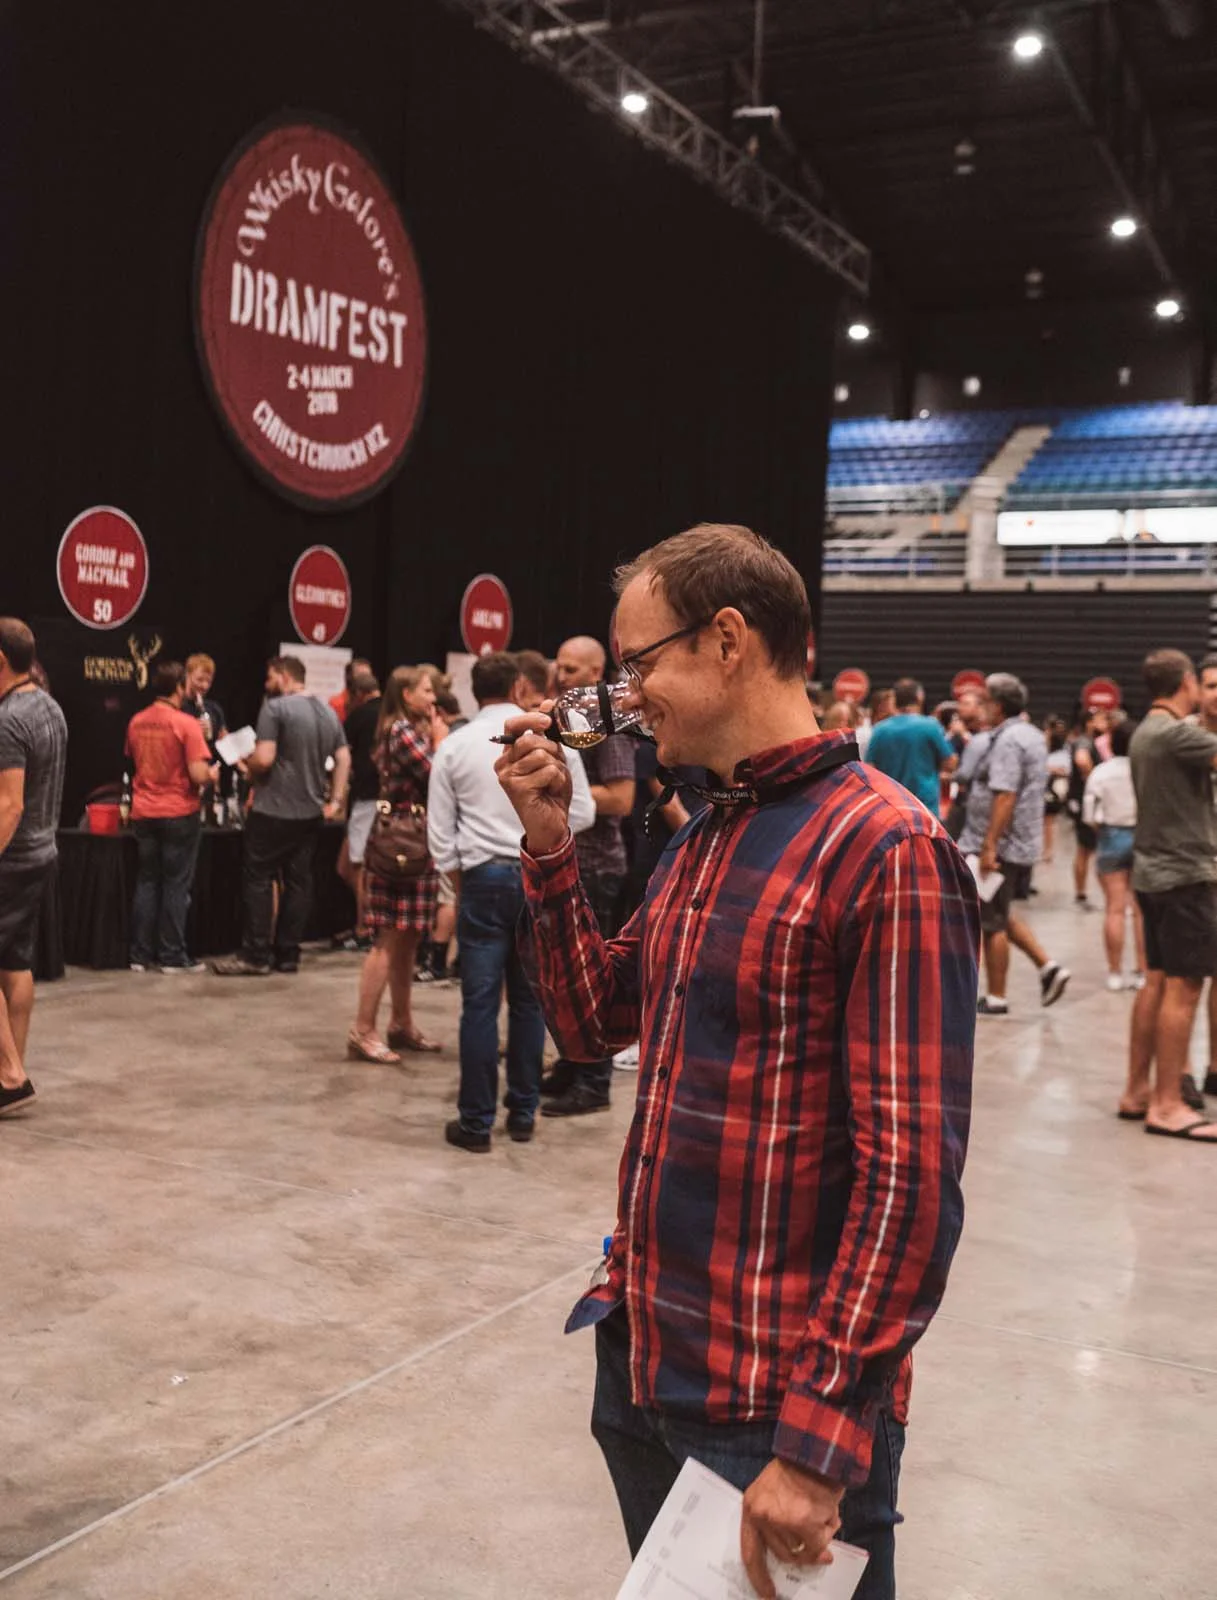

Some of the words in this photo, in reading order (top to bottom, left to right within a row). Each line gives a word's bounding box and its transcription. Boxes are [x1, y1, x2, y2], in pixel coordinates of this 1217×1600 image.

[236, 153, 321, 257] Whisky
[324, 161, 400, 302] Galore's
[230, 261, 408, 368] DRAMFEST
[252, 399, 368, 471] CHRISTCHURCH
[93, 598, 112, 622] 50
